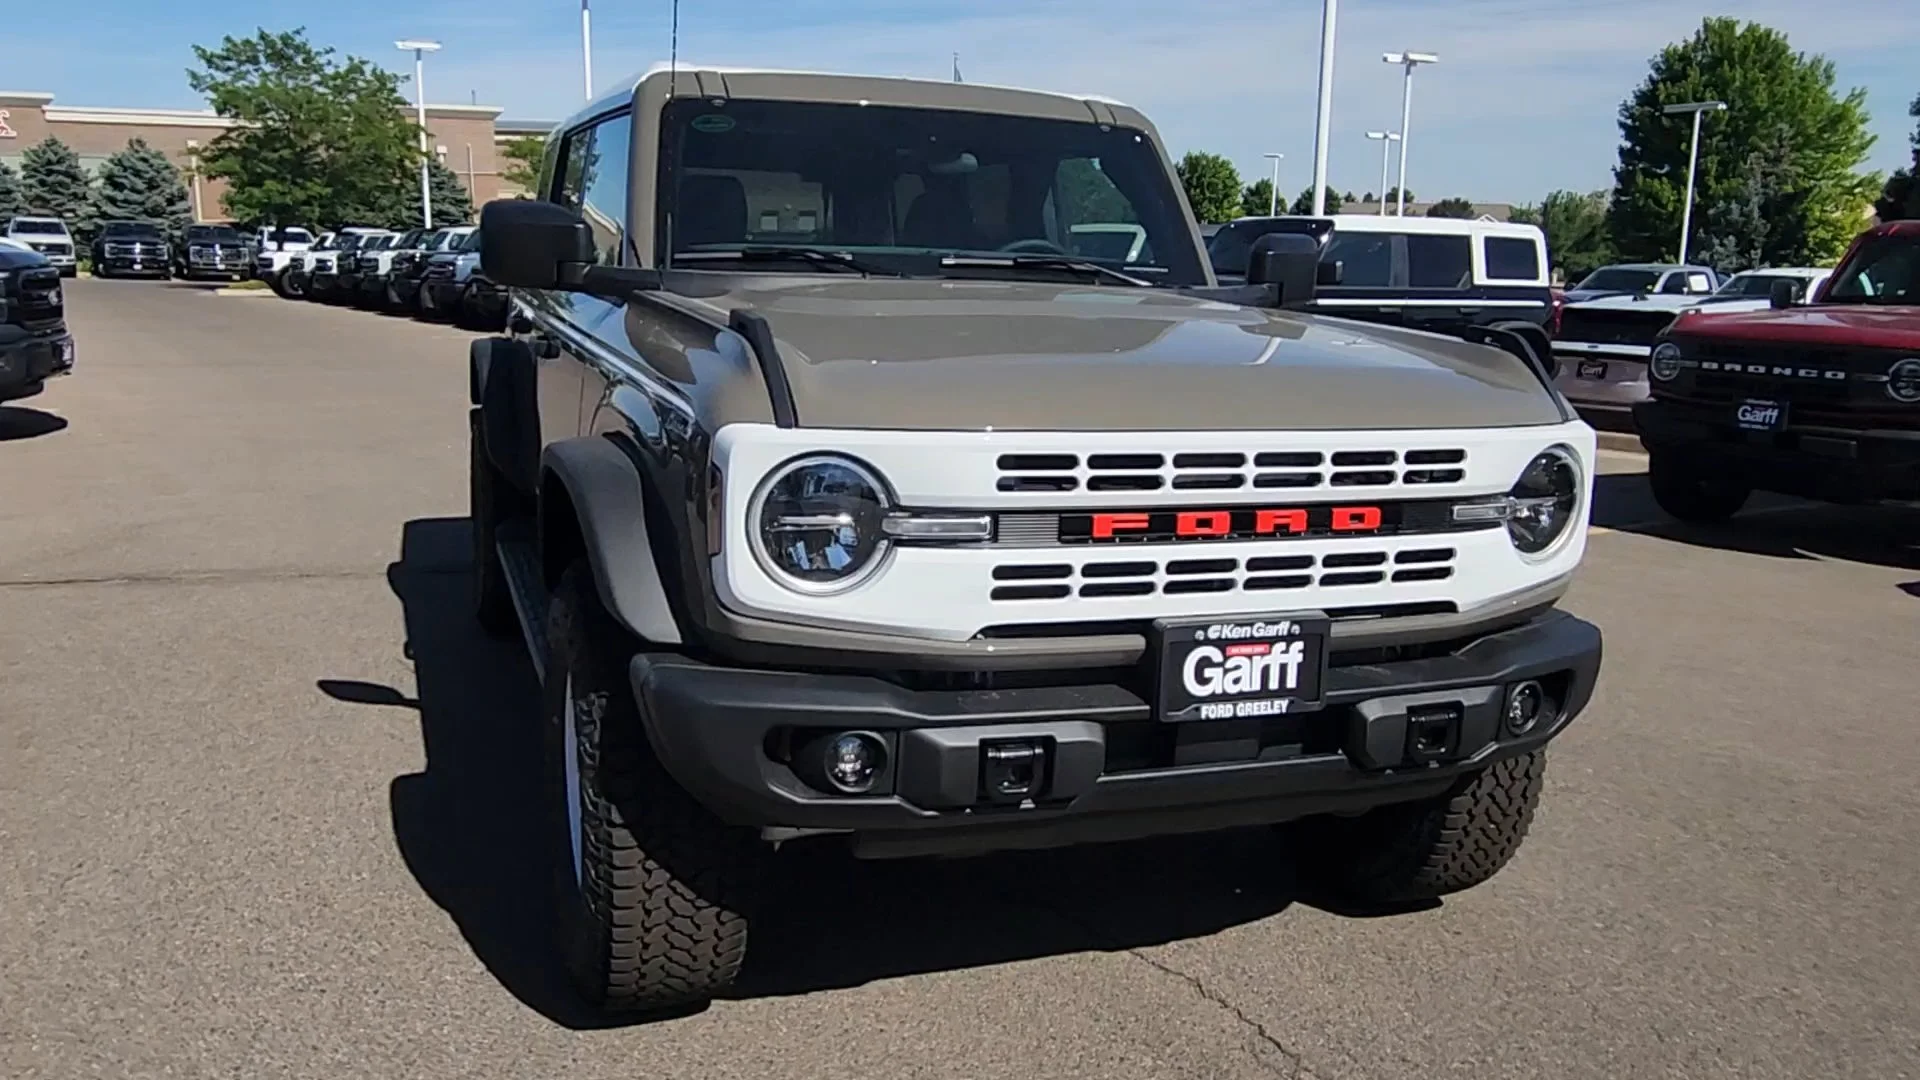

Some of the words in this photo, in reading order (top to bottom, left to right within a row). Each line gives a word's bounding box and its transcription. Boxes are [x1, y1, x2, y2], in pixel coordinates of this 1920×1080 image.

[1701, 361, 1846, 380] BRONCO
[1737, 405, 1779, 425] Garff
[1091, 506, 1382, 538] FORD
[1221, 624, 1251, 639] Ken
[1252, 621, 1291, 638] Garff
[1182, 641, 1305, 697] Garff
[1200, 703, 1234, 720] FORD
[1236, 699, 1290, 716] GREELEY
